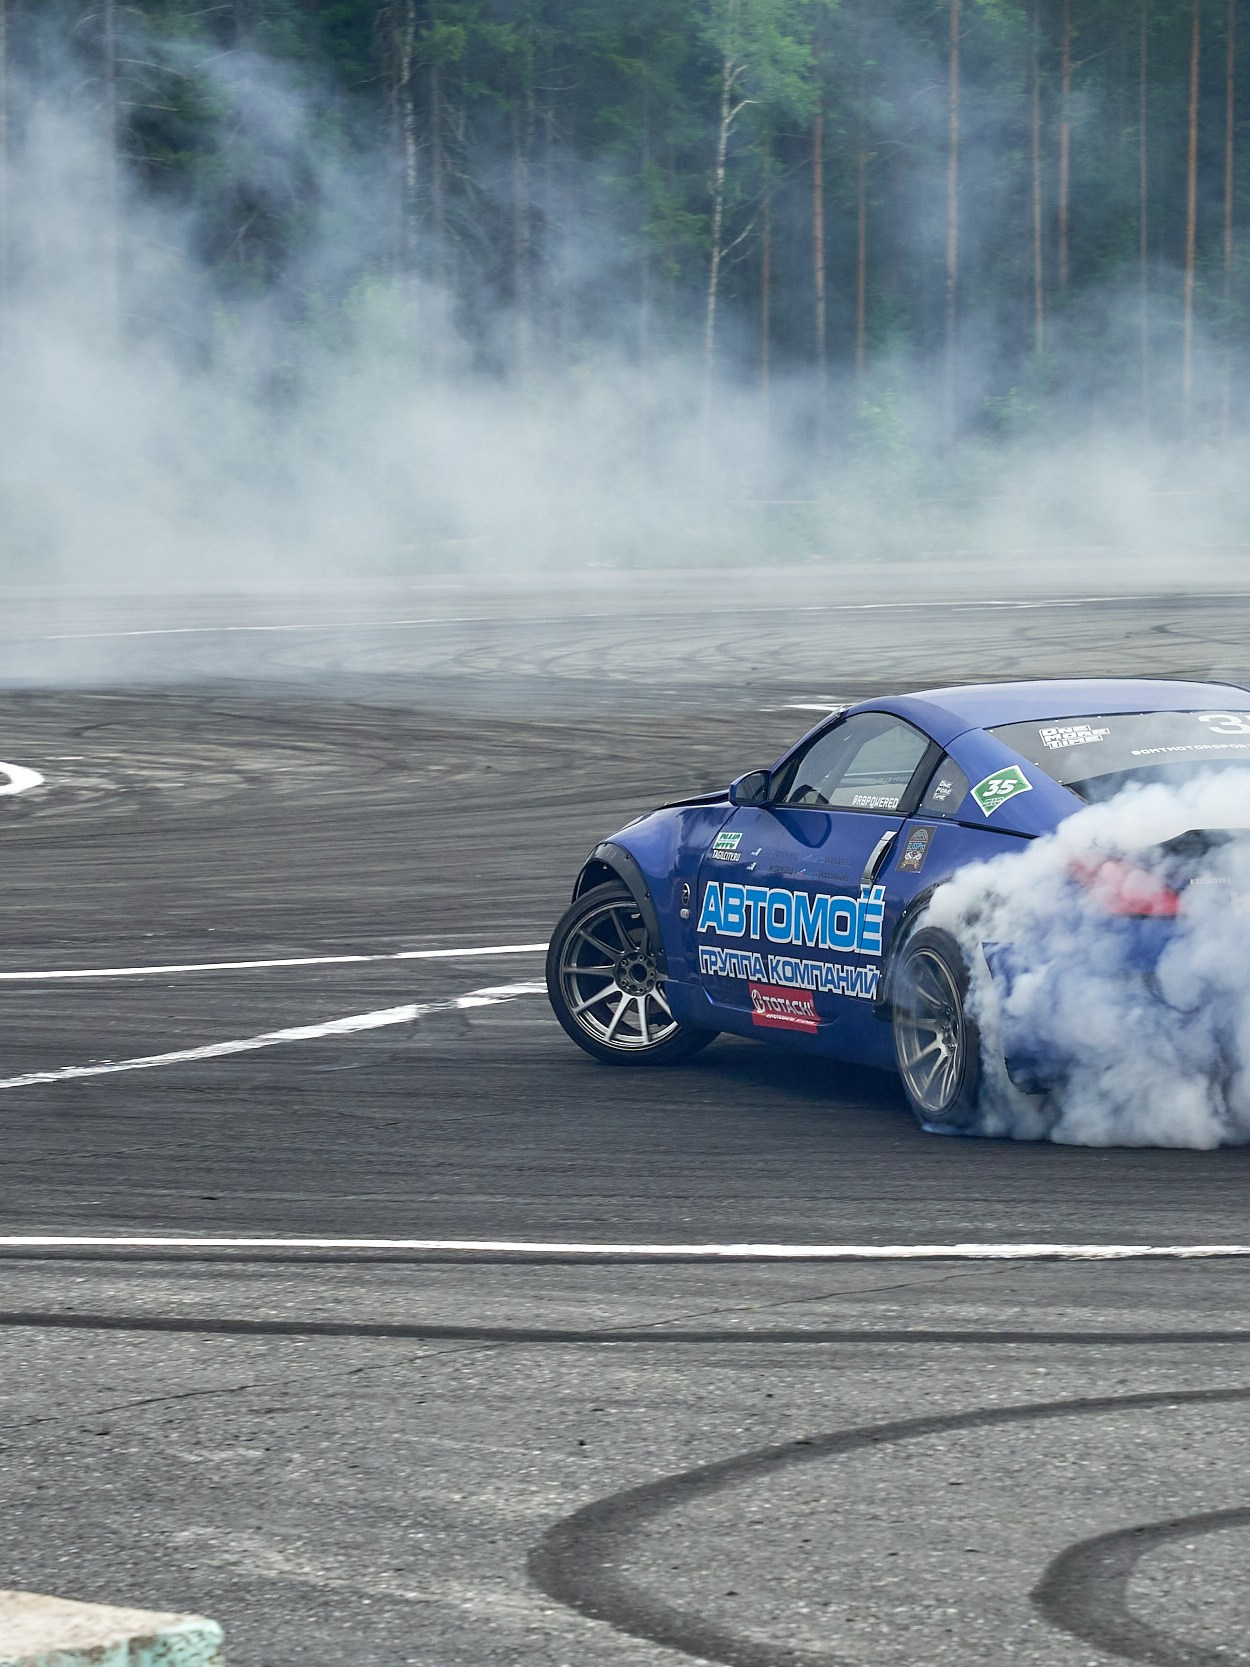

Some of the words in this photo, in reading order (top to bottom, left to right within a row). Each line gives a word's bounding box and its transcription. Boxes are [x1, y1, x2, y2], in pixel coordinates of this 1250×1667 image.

[1040, 725, 1091, 737] ONE
[1043, 728, 1110, 743] MORE
[1048, 735, 1103, 749] TIME
[982, 779, 1018, 797] 35
[852, 794, 899, 809] @RBPOWERED
[697, 880, 886, 956] АВТОМОЁ
[699, 945, 768, 983] ГРУППА
[767, 954, 881, 1000] КОМПАНИЙ
[762, 996, 814, 1016] TOTACHI
